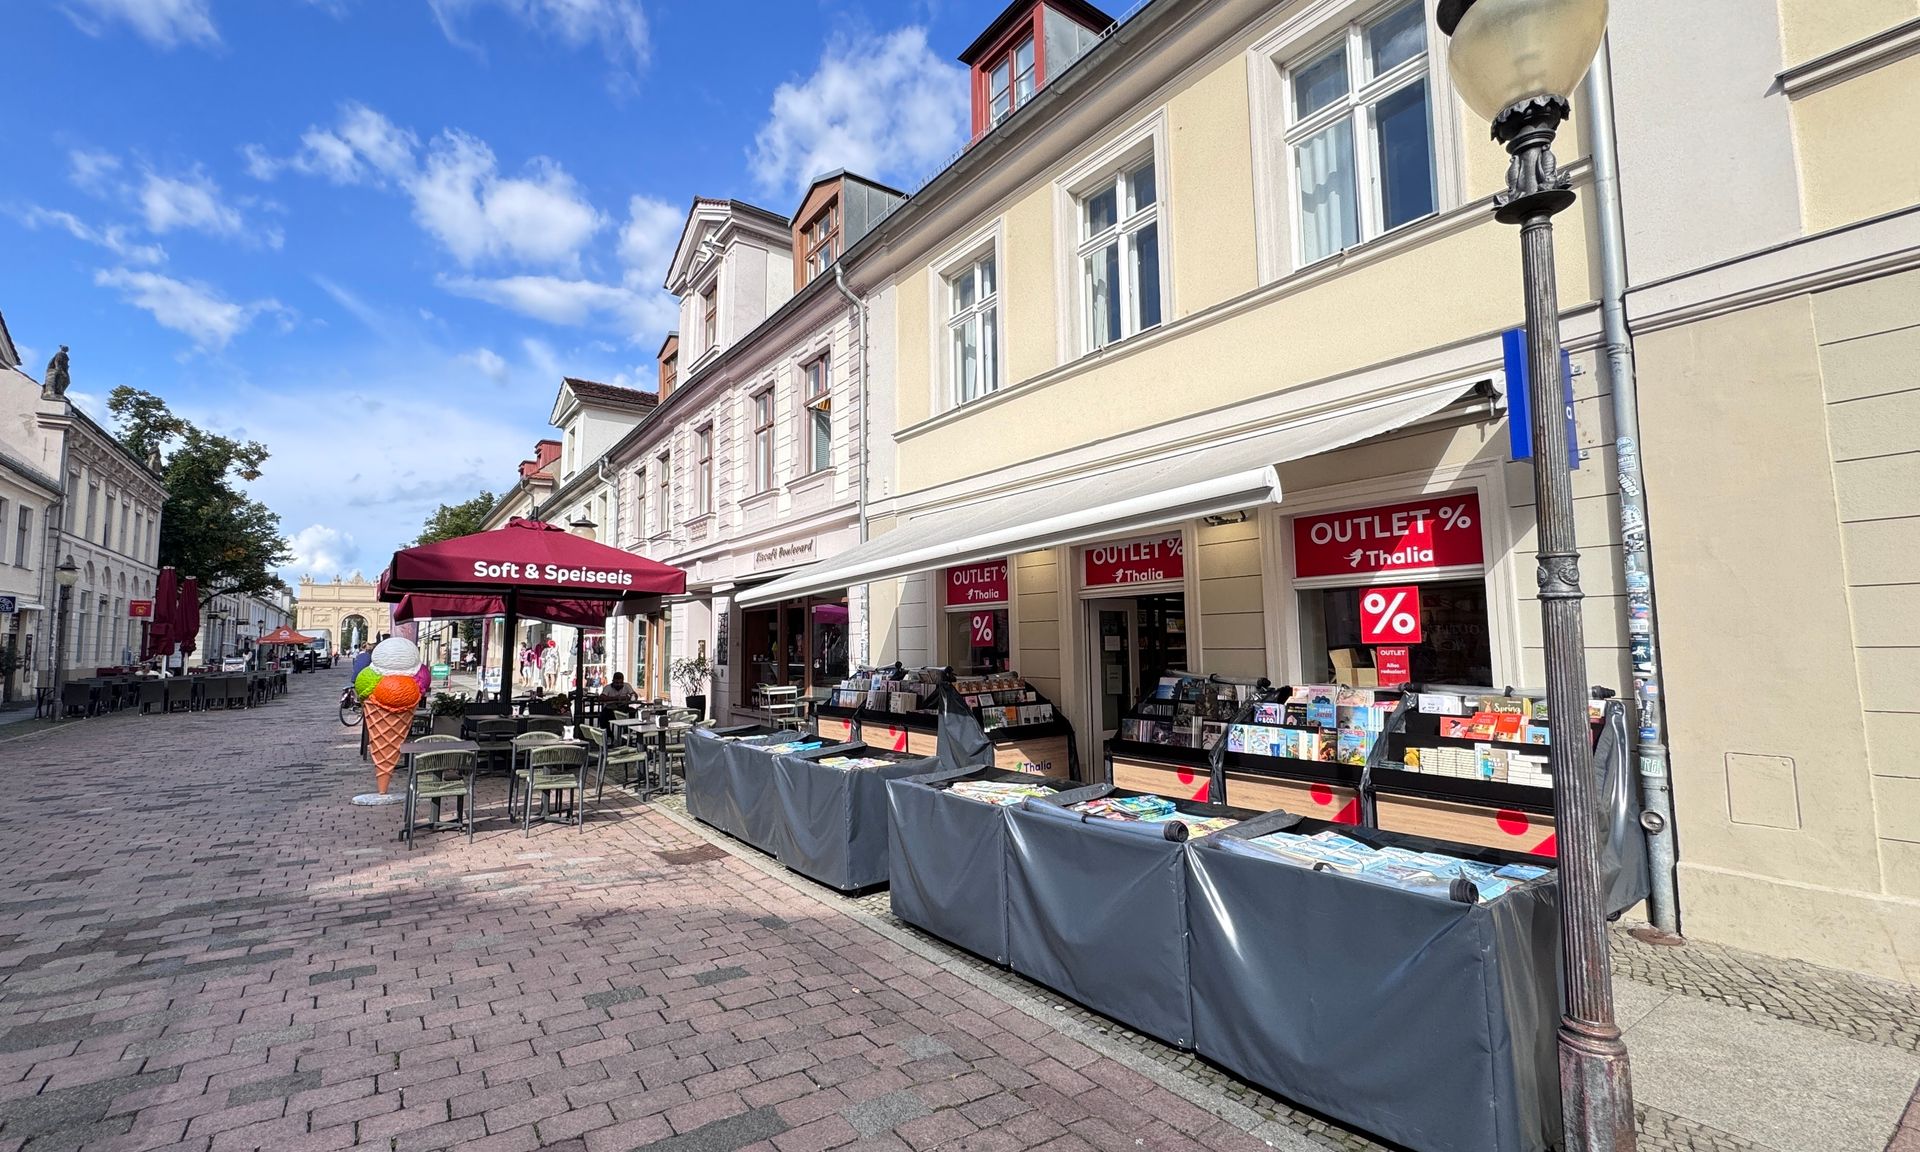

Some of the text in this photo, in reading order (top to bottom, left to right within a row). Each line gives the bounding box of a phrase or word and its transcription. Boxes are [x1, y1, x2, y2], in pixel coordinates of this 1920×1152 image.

[1310, 504, 1472, 545] OUTLET %
[779, 539, 814, 559] Boulevard
[1092, 540, 1162, 565] OUTLET
[1366, 546, 1433, 566] Thalia
[473, 561, 633, 585] Soft & Speiseeis
[953, 566, 999, 585] OUTLET
[1125, 568, 1164, 582] Thalia
[974, 589, 999, 600] Thalia
[1363, 592, 1416, 635] %
[972, 615, 992, 641] %
[1493, 702, 1521, 714] Spring
[1023, 760, 1052, 773] Thalia
